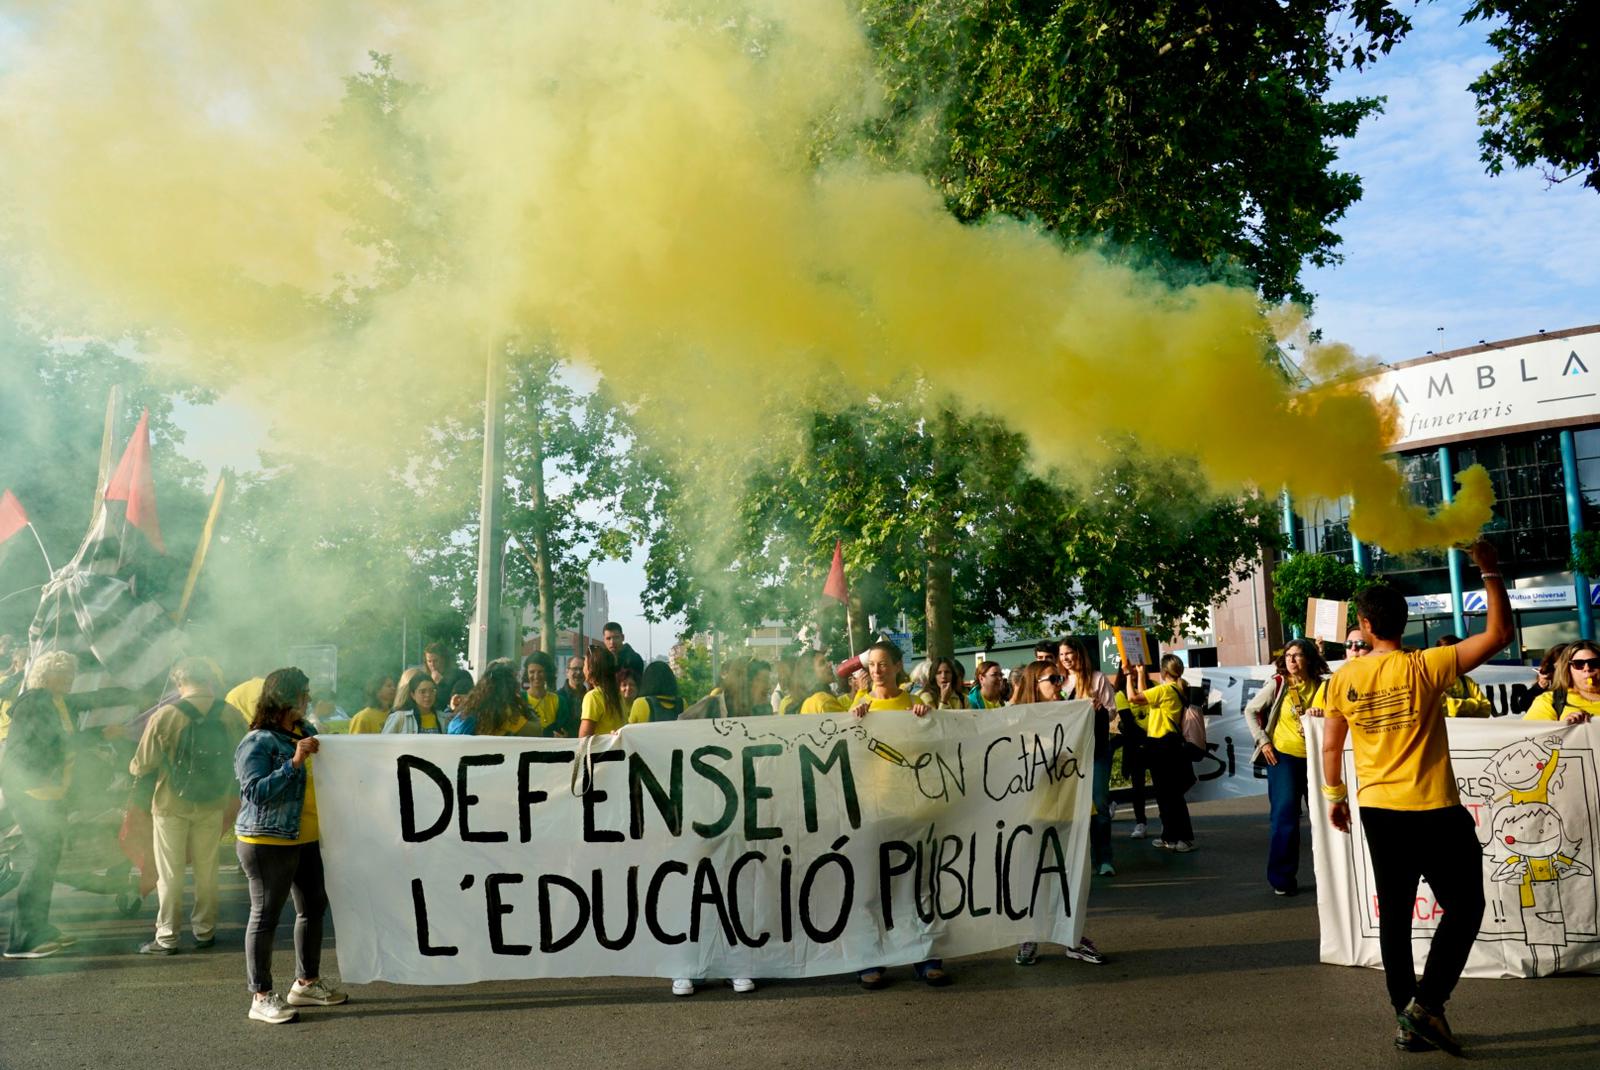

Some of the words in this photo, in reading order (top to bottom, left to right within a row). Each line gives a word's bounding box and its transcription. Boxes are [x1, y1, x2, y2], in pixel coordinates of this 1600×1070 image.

[1403, 400, 1514, 438] funeraris
[1532, 591, 1567, 599] Universal
[397, 739, 861, 843] DEFENSEM
